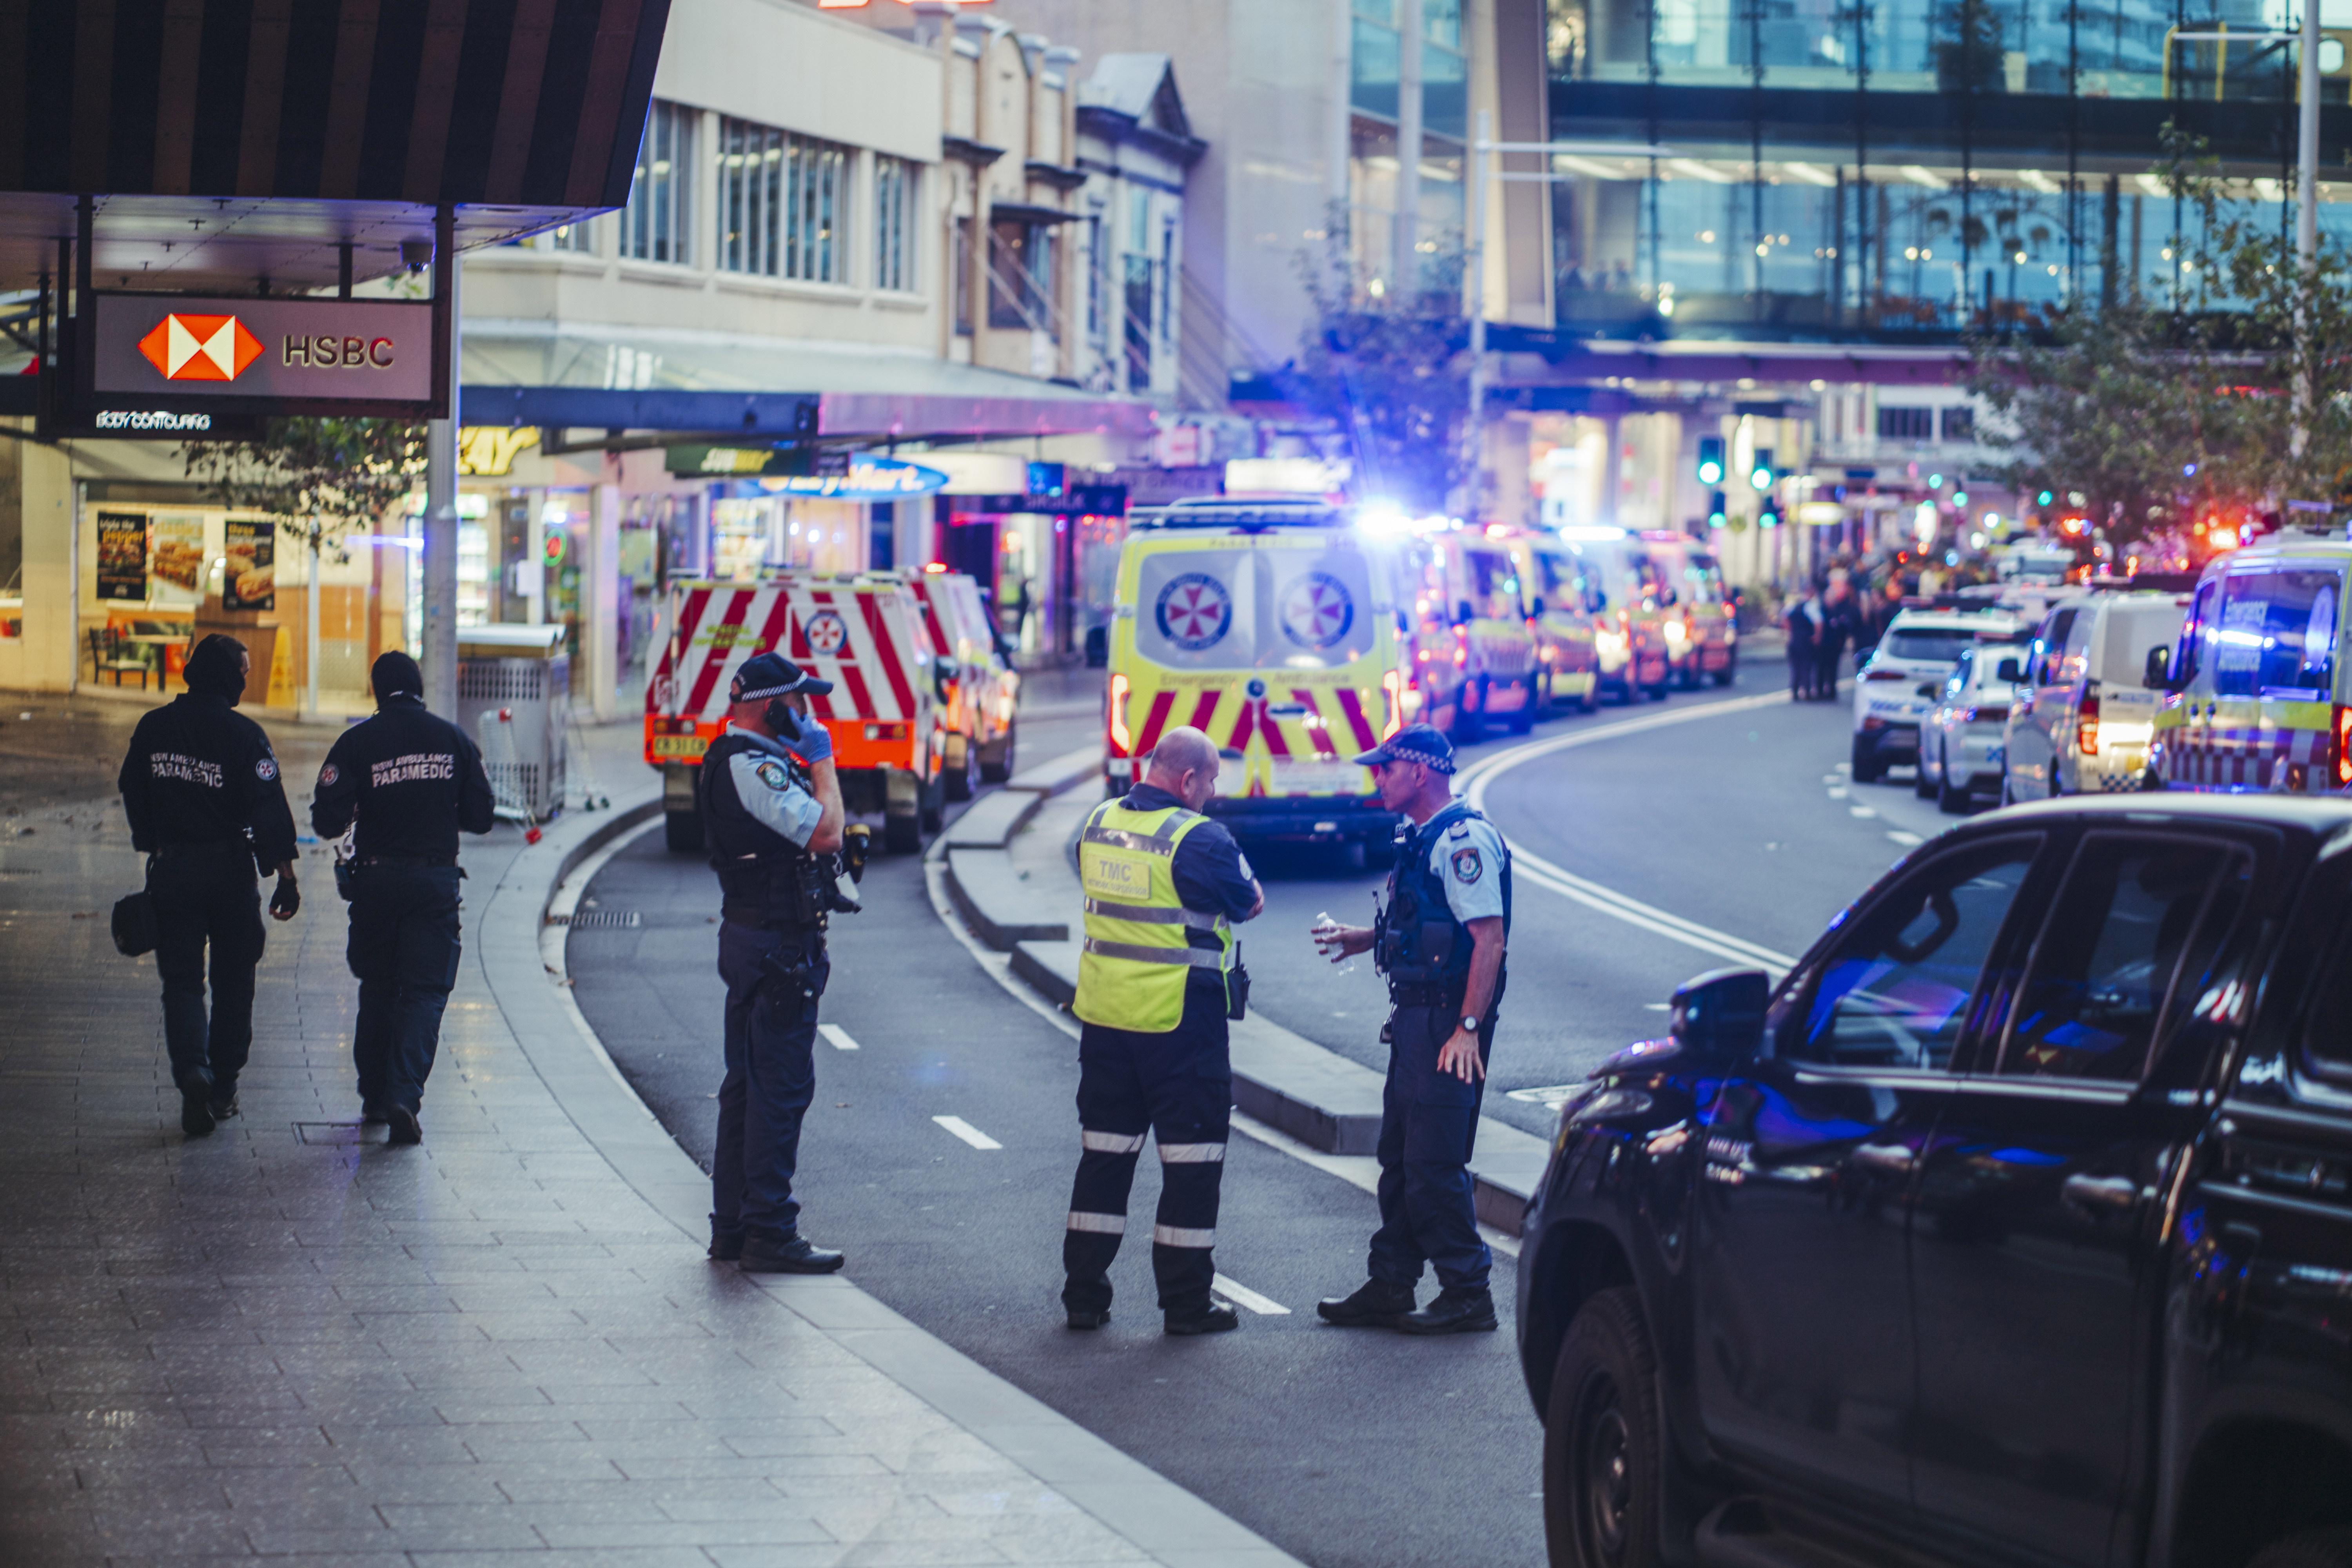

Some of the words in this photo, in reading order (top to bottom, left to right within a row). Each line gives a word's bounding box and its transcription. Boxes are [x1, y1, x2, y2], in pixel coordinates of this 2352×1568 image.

[283, 334, 394, 369] HSBC
[96, 411, 132, 428] BODY
[131, 411, 211, 430] CONTOURING
[701, 448, 774, 472] SUBWAY
[103, 530, 144, 544] pepper
[1160, 672, 1236, 688] Emergency
[1272, 671, 1350, 684] Ambulance
[396, 753, 454, 767] AMBULANCE
[152, 763, 223, 788] PARAMEDIC
[372, 764, 454, 788] PARAMEDIC
[1099, 860, 1131, 882] TMC
